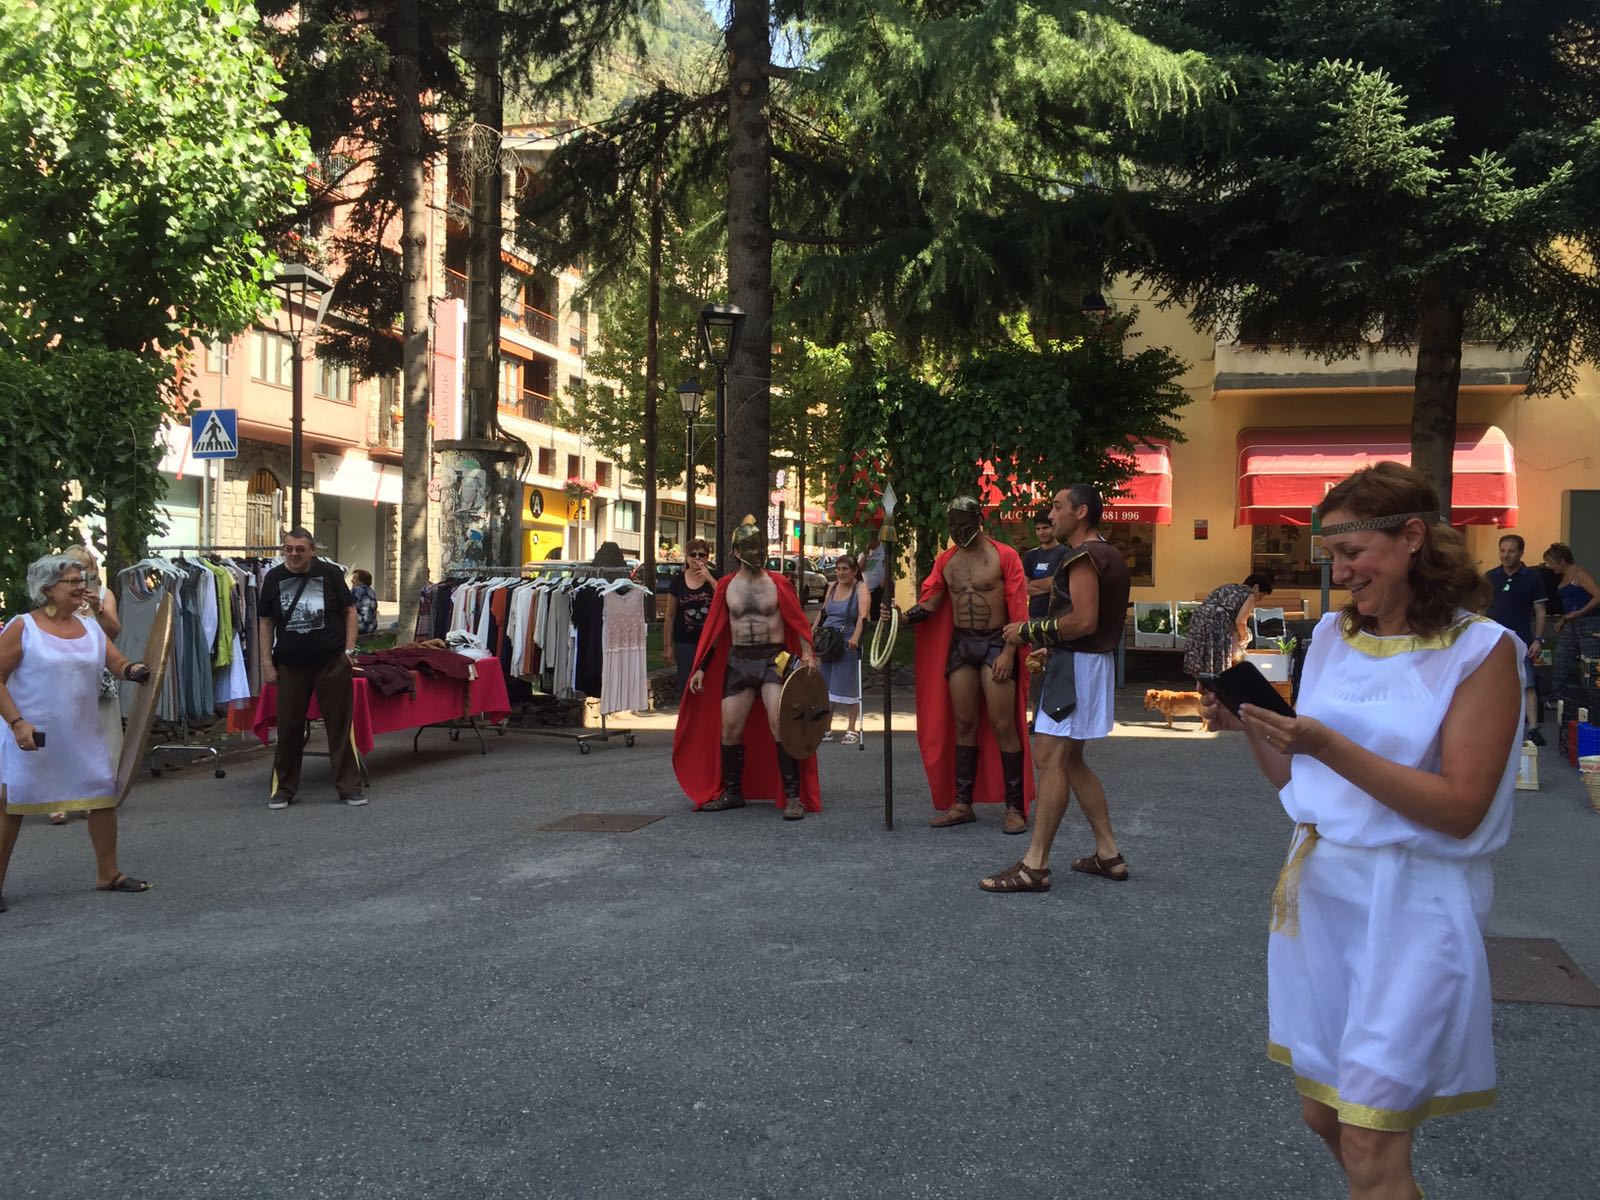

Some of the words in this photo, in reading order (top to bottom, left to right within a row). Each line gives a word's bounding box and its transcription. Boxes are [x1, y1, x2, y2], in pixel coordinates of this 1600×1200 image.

[440, 371, 450, 440] NDBANK
[1102, 511, 1119, 520] 681
[1122, 511, 1140, 520] 996
